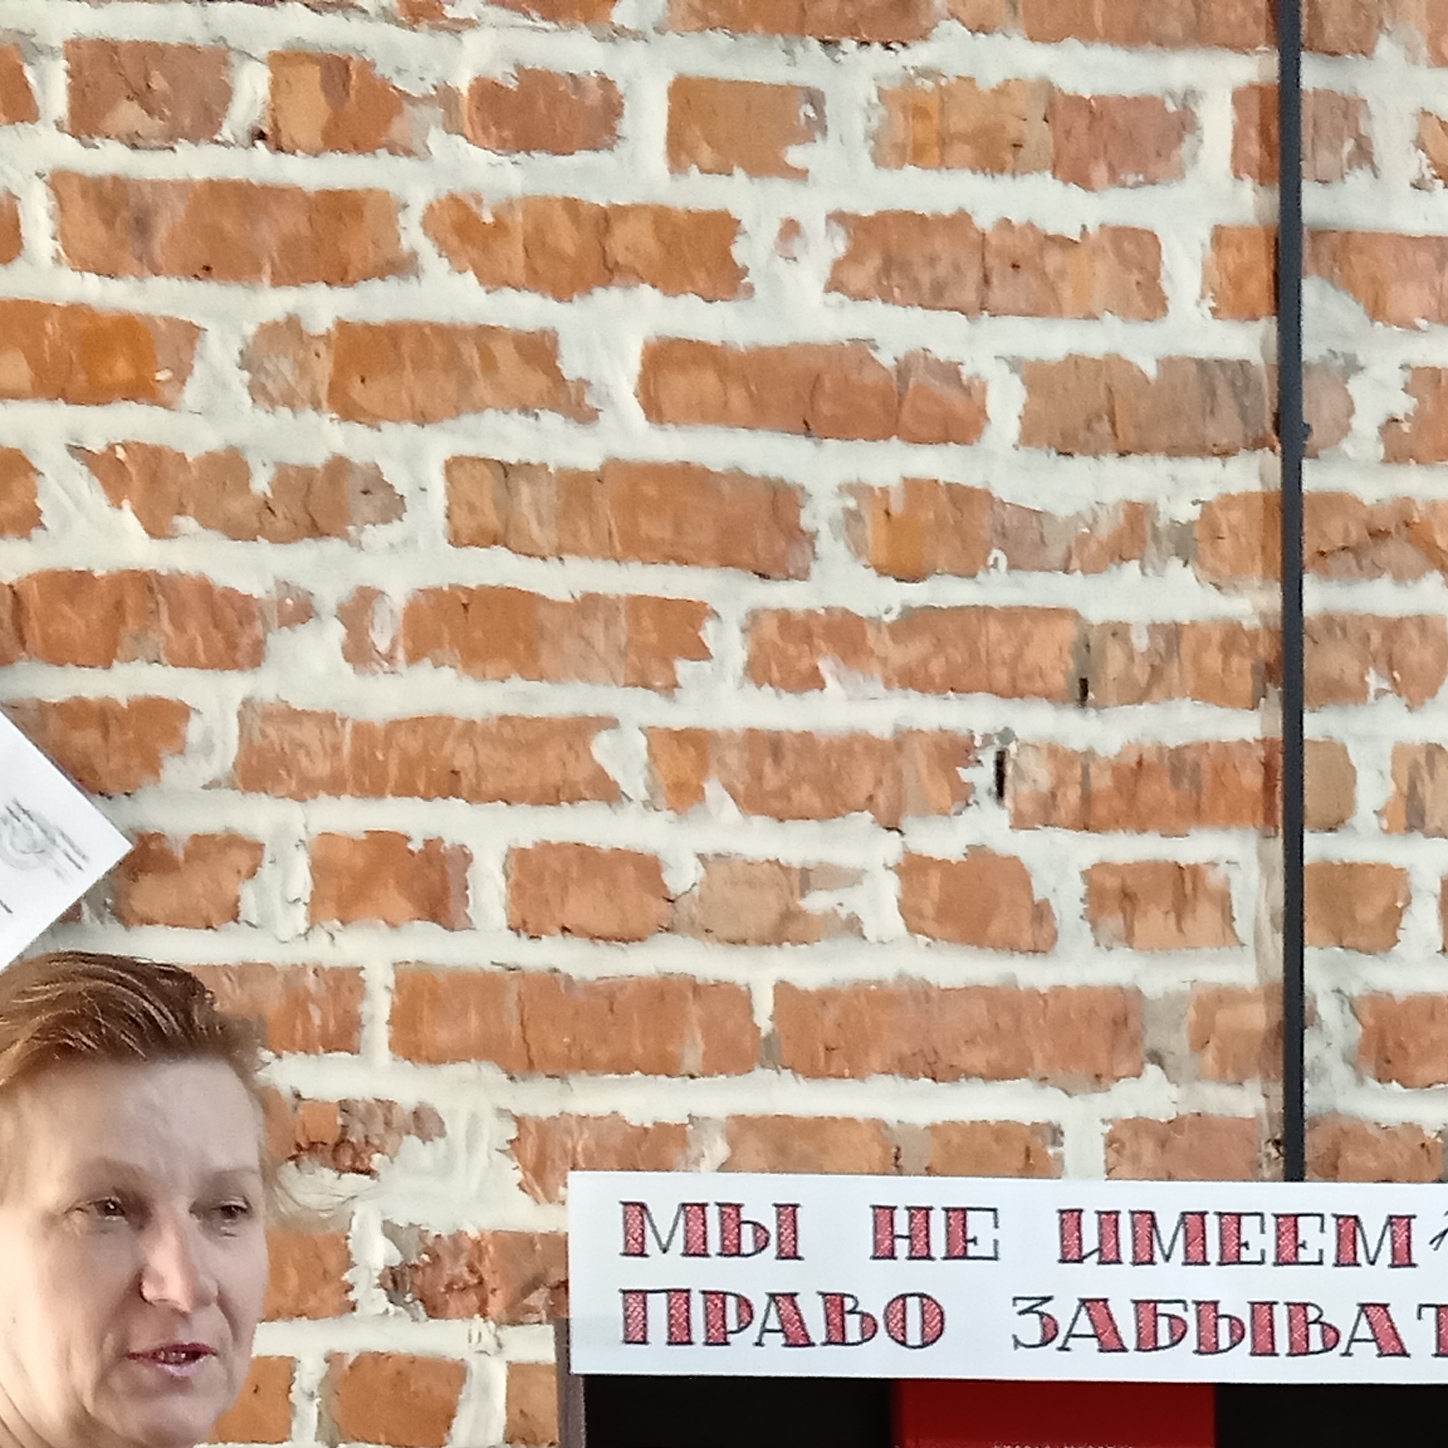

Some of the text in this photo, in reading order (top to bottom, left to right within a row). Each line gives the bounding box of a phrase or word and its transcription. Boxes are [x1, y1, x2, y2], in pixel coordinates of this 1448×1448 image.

[618, 1198, 1419, 1271] МЫ НЕ ИМЕЕМ
[618, 1285, 947, 1352] ПРАВО
